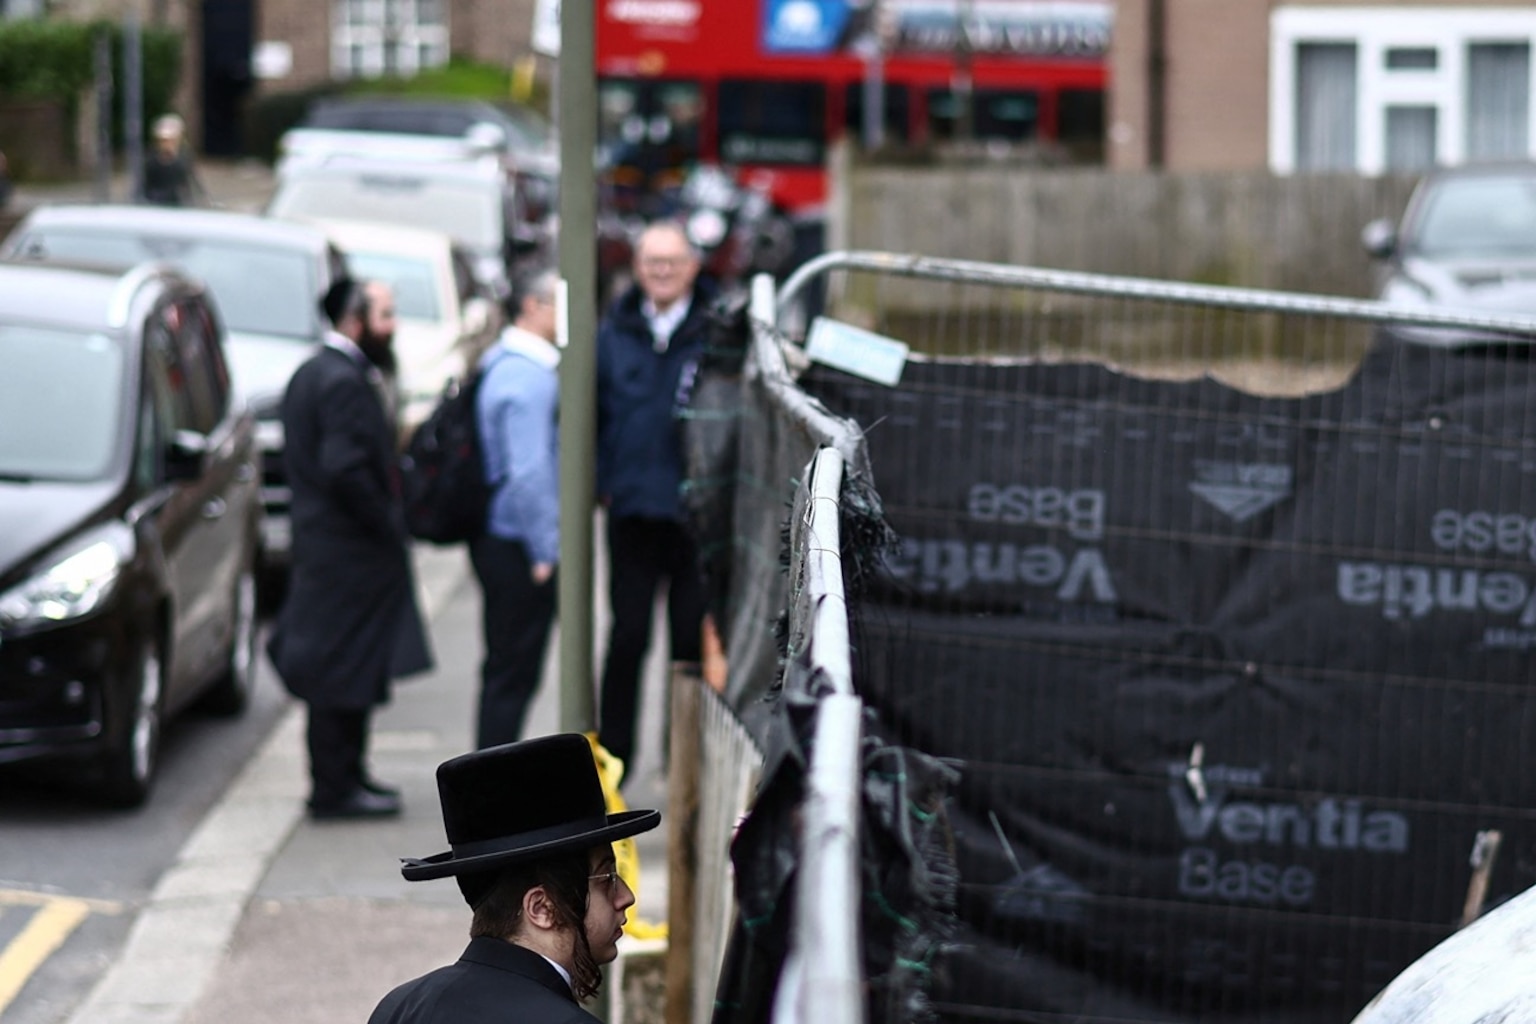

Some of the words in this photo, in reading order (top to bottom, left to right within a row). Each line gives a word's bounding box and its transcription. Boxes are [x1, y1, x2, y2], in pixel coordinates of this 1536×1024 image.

[967, 482, 1106, 541] Base
[1168, 782, 1410, 854] Ventia
[1178, 846, 1316, 906] Base
